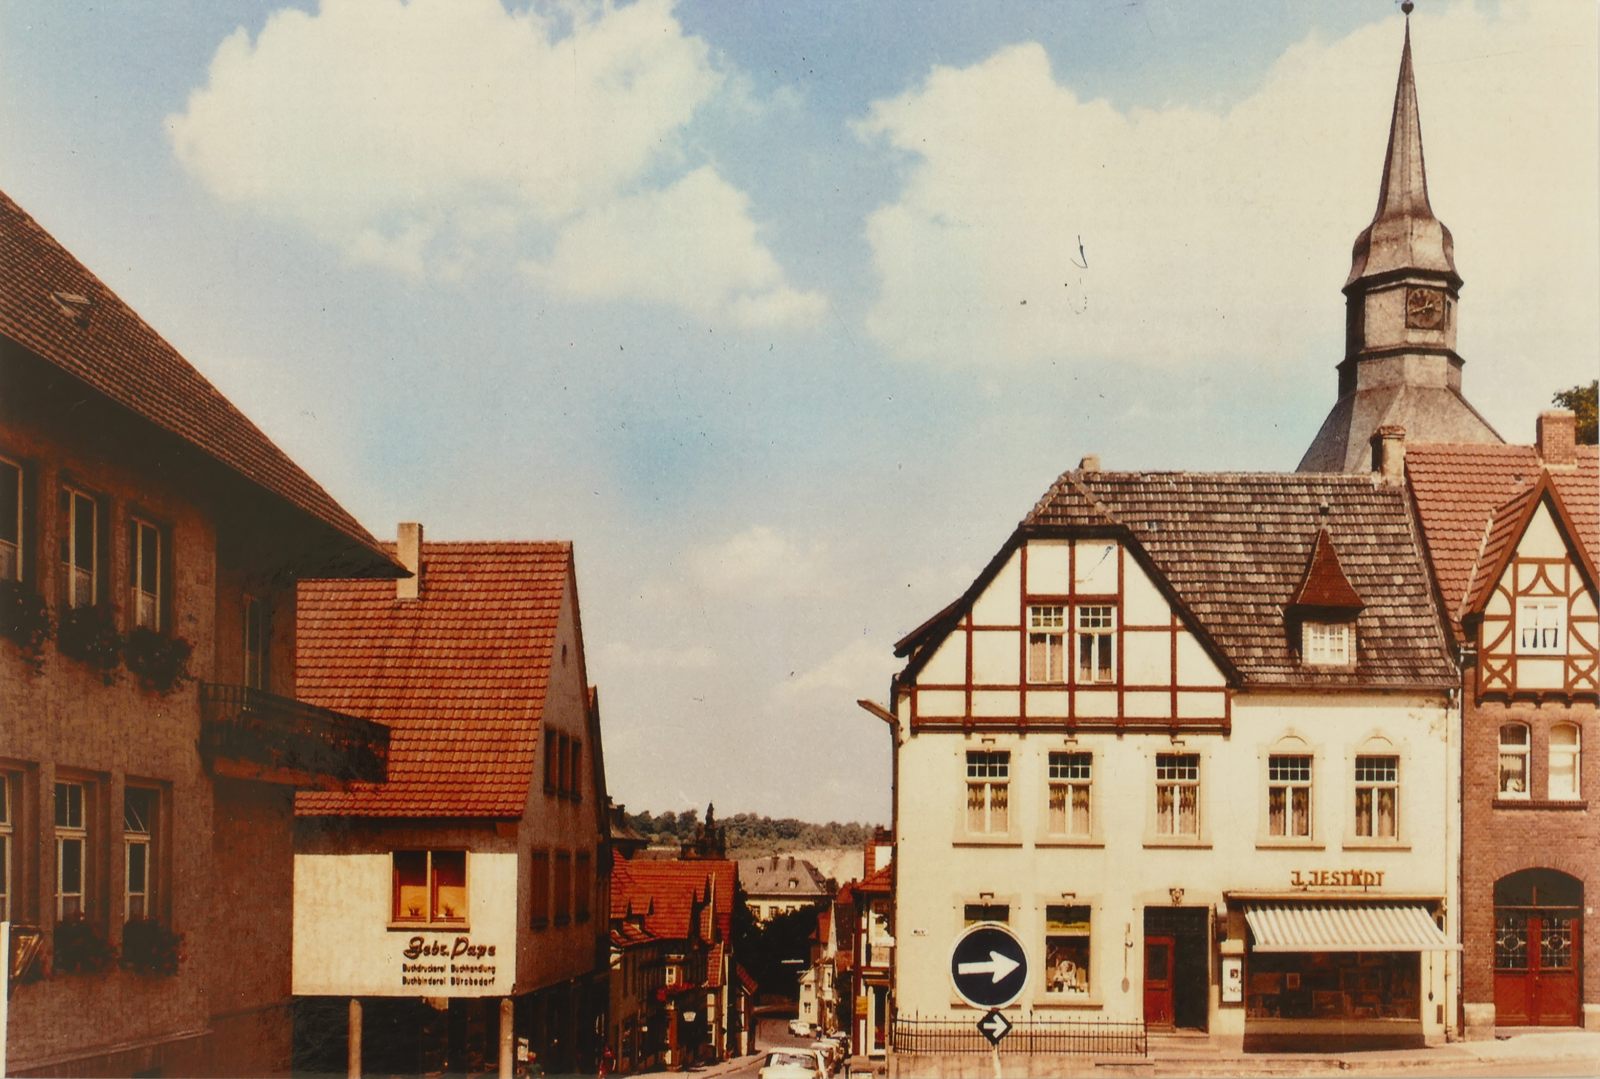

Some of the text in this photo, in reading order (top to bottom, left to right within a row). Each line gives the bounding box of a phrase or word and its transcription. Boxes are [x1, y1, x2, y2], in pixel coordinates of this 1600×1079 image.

[403, 936, 497, 960] Gebr. Pape
[402, 963, 496, 975] Buchdruckerei Buchhandlung
[402, 975, 446, 986] Buchbinderei
